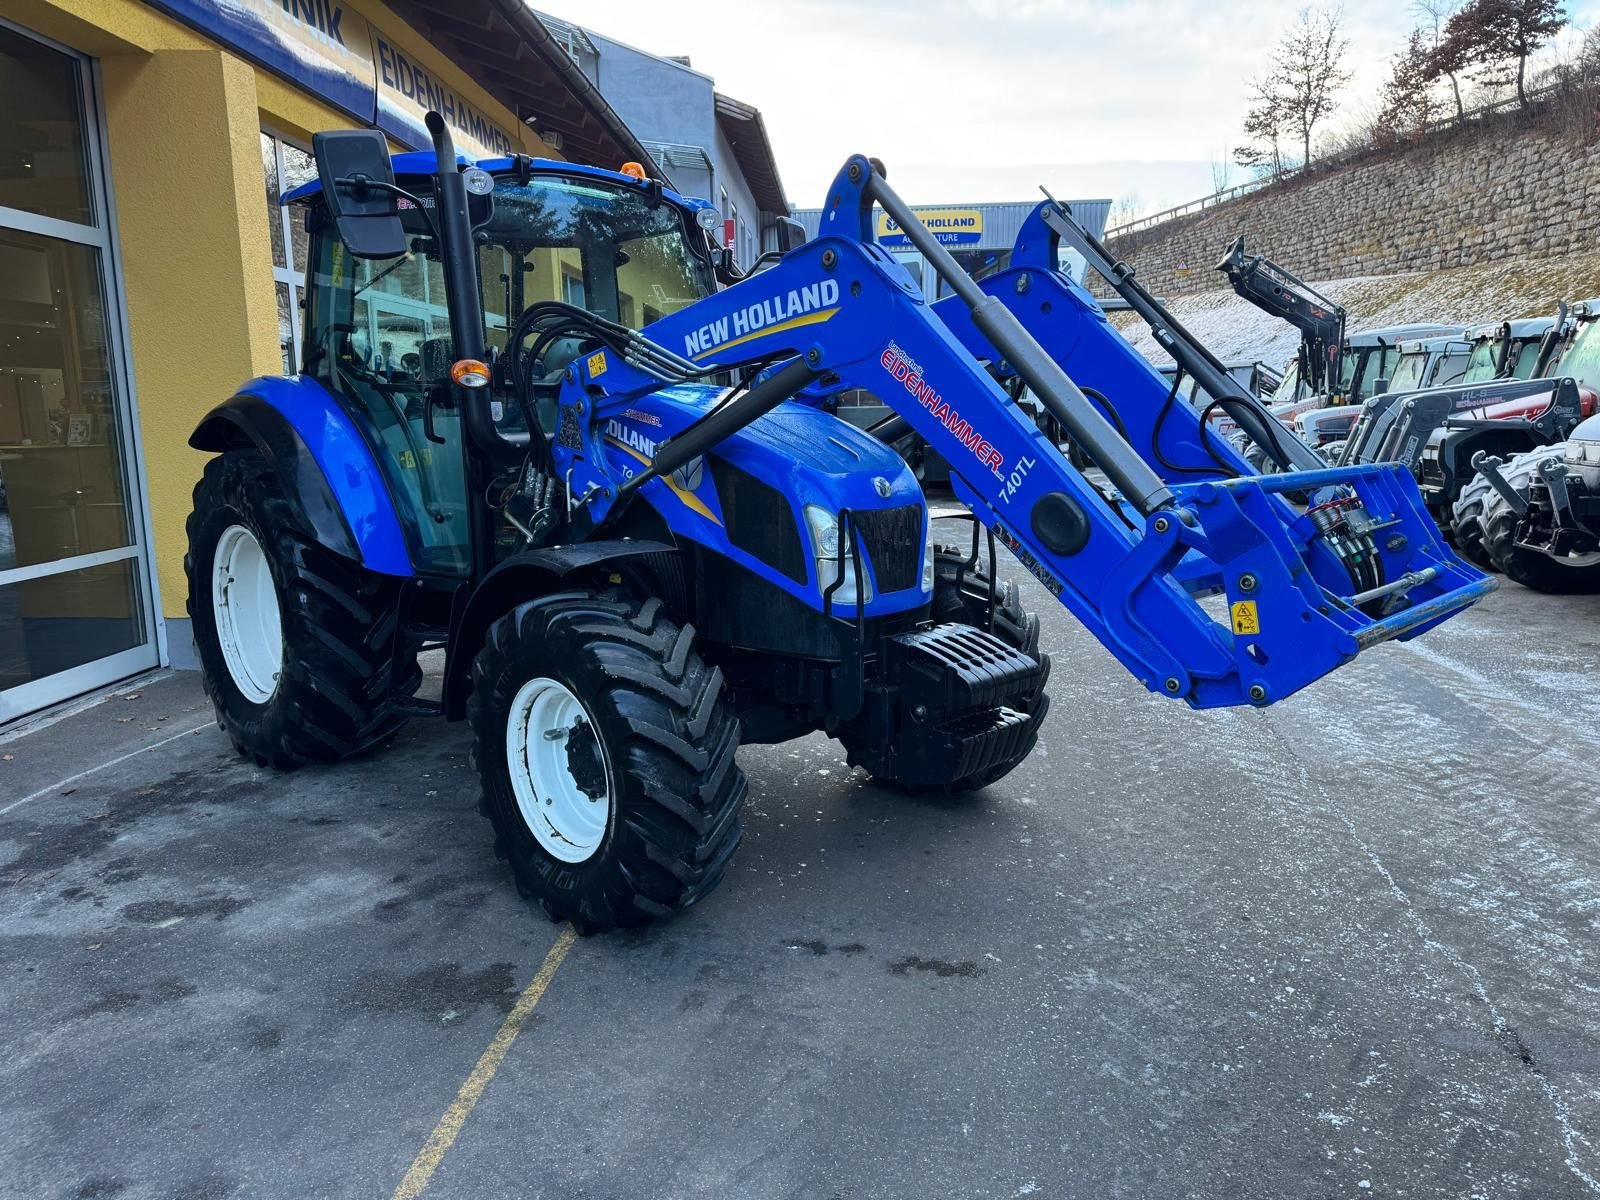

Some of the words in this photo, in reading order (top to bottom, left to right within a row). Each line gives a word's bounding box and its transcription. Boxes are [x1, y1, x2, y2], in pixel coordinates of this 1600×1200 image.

[282, 0, 346, 47] NIK
[927, 217, 975, 228] HOLLAND
[684, 316, 729, 357] NEW
[732, 278, 840, 337] HOLLAND
[880, 347, 1004, 474] EIDENHAMMER
[998, 455, 1036, 505] 740TL
